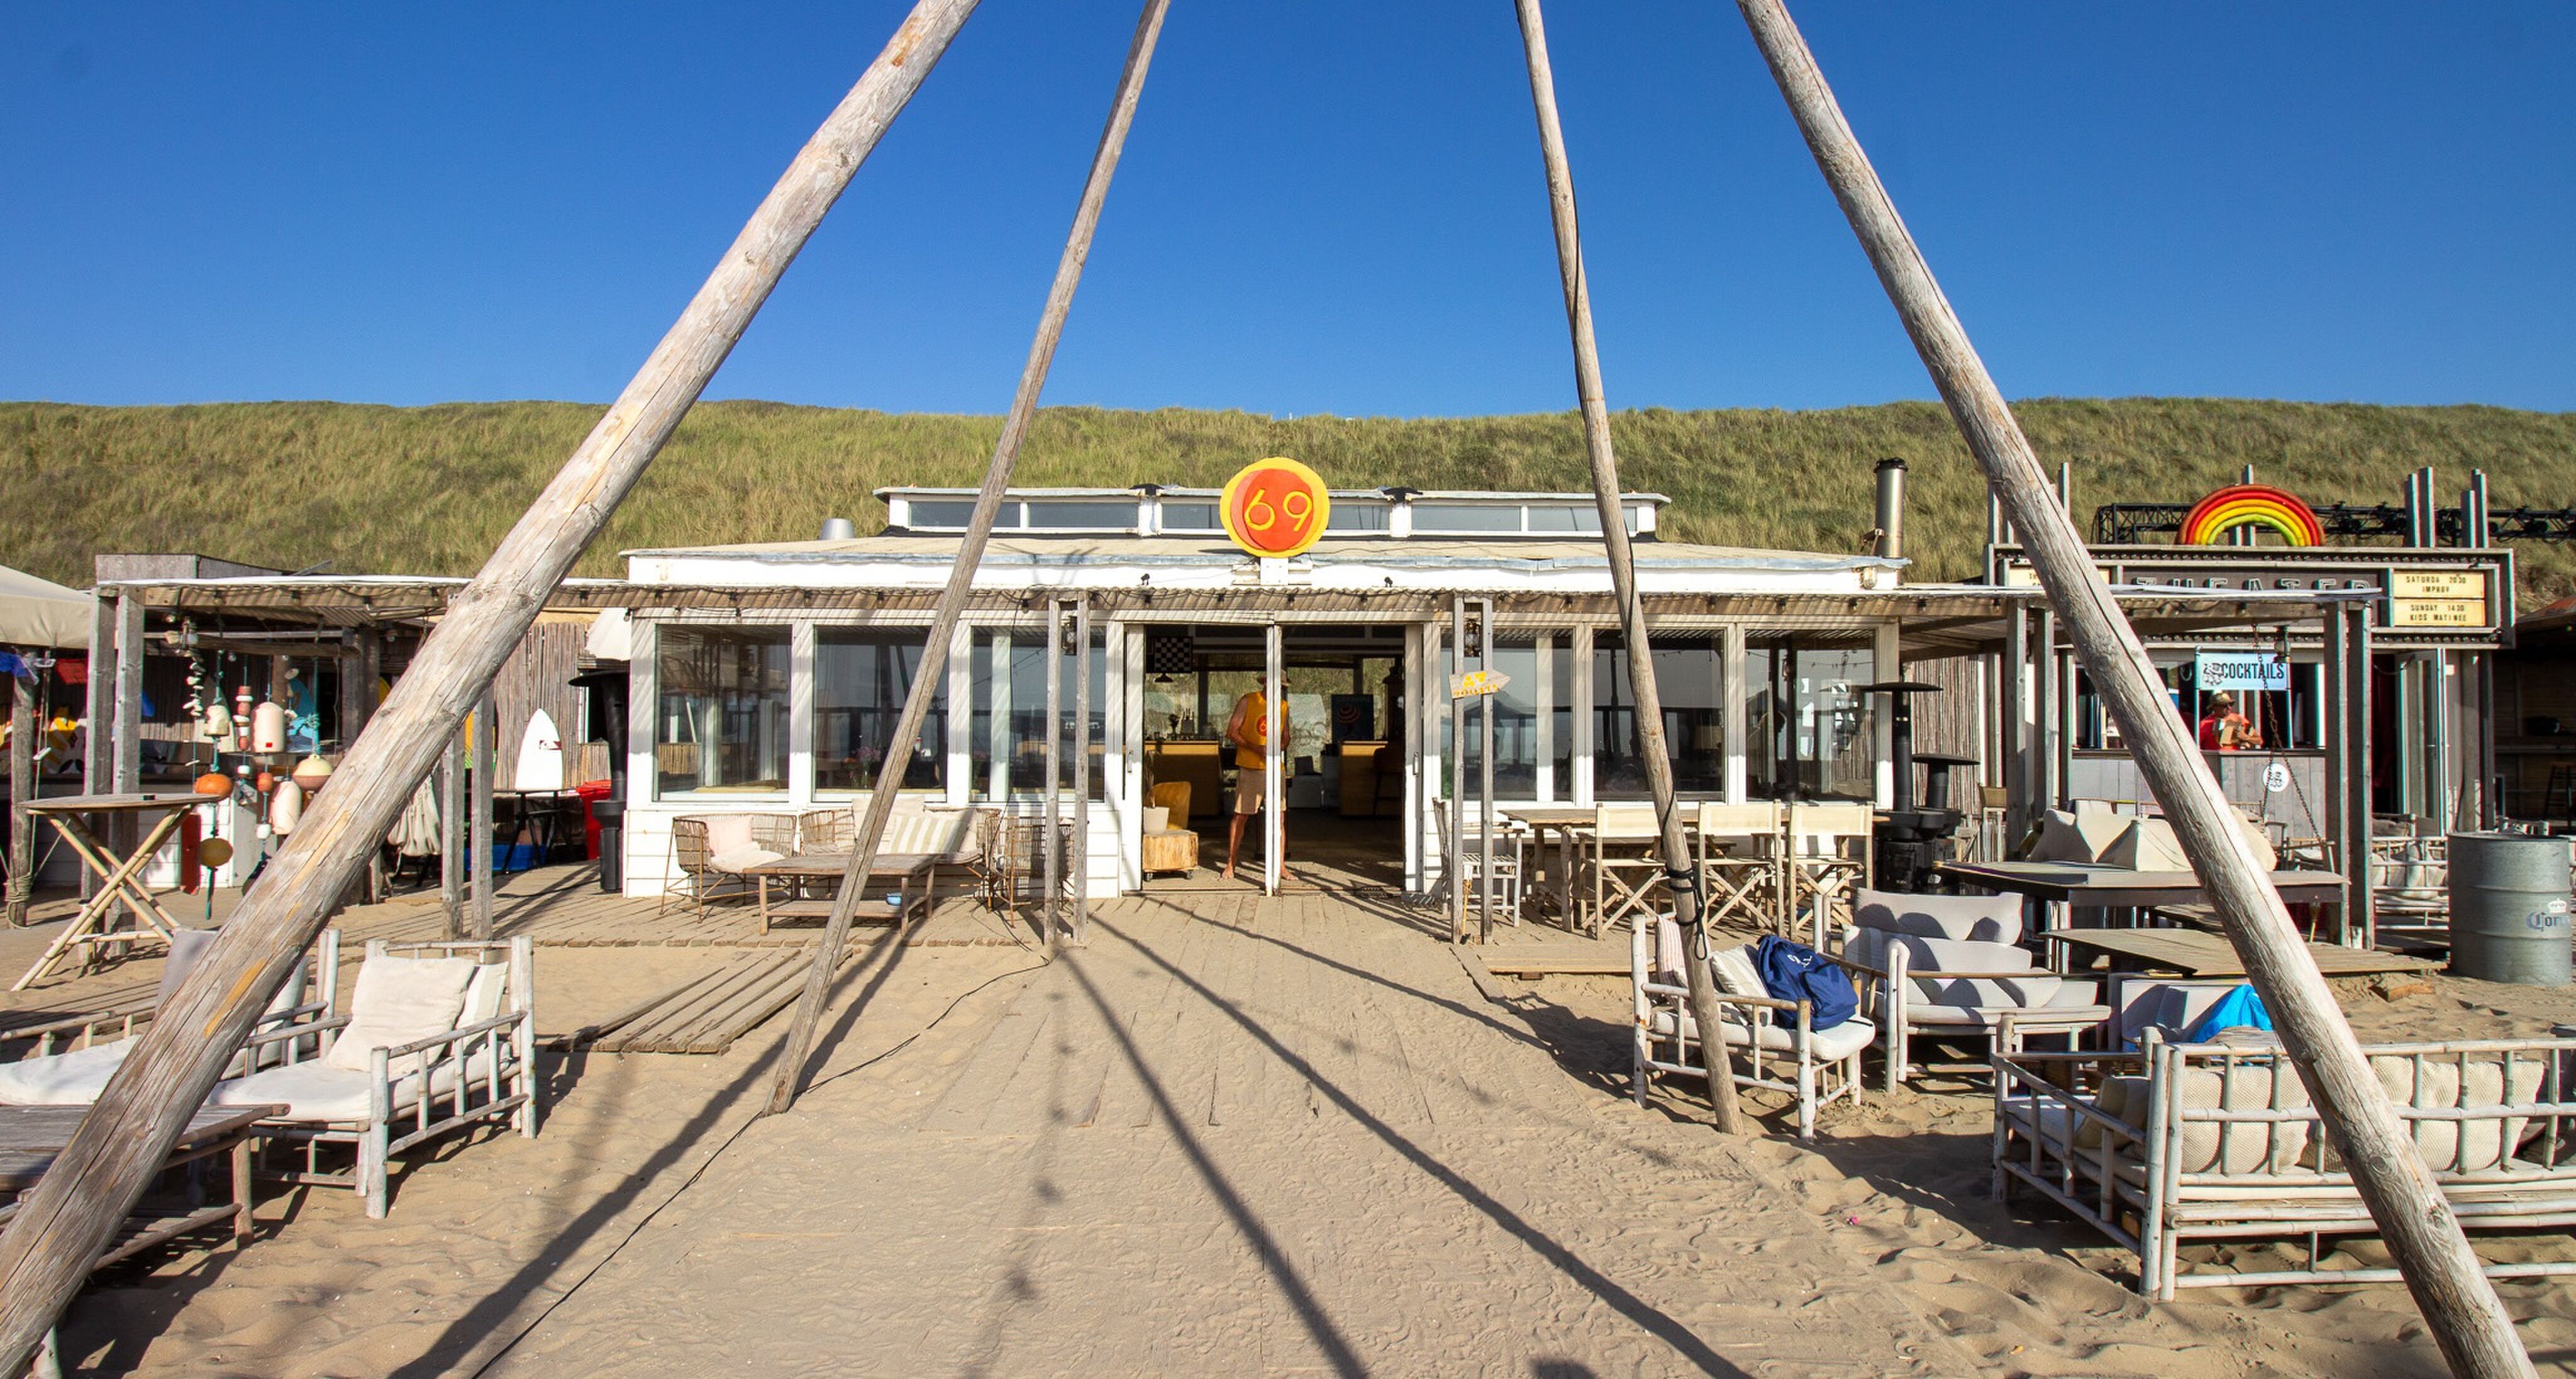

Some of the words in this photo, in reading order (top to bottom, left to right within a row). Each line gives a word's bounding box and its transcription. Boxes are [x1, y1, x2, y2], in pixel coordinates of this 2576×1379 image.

[1244, 488, 1313, 532] 69
[2433, 614, 2466, 622] MATINEE
[2223, 662, 2285, 679] COCKTAILS
